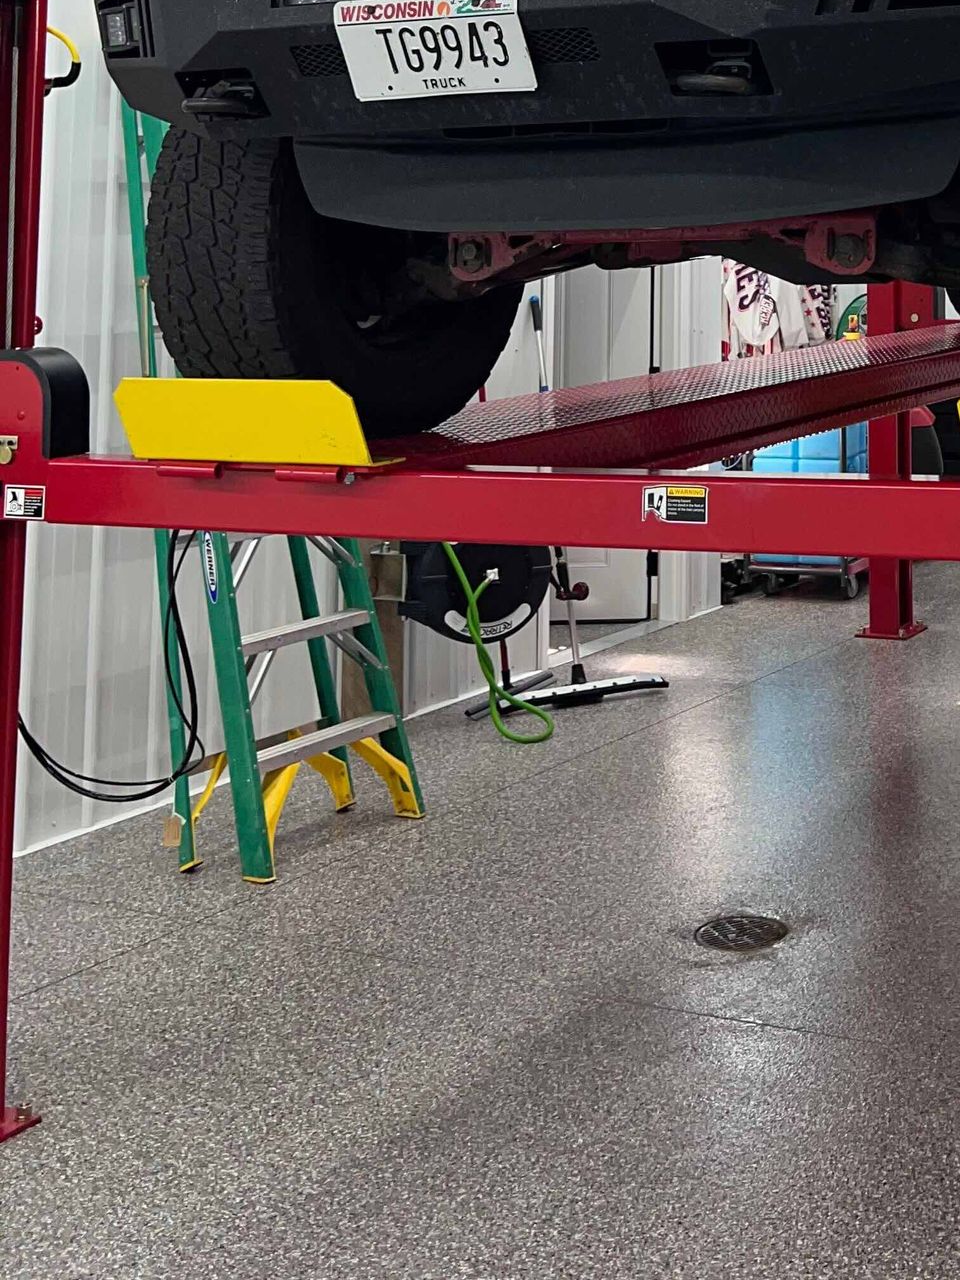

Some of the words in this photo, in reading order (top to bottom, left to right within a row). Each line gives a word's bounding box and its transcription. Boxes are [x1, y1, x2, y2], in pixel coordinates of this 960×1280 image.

[340, 0, 435, 23] WISCONSIN
[375, 21, 510, 75] TG9943
[422, 77, 467, 90] TRUCK
[674, 487, 704, 496] WARNING
[205, 538, 215, 586] WERNER
